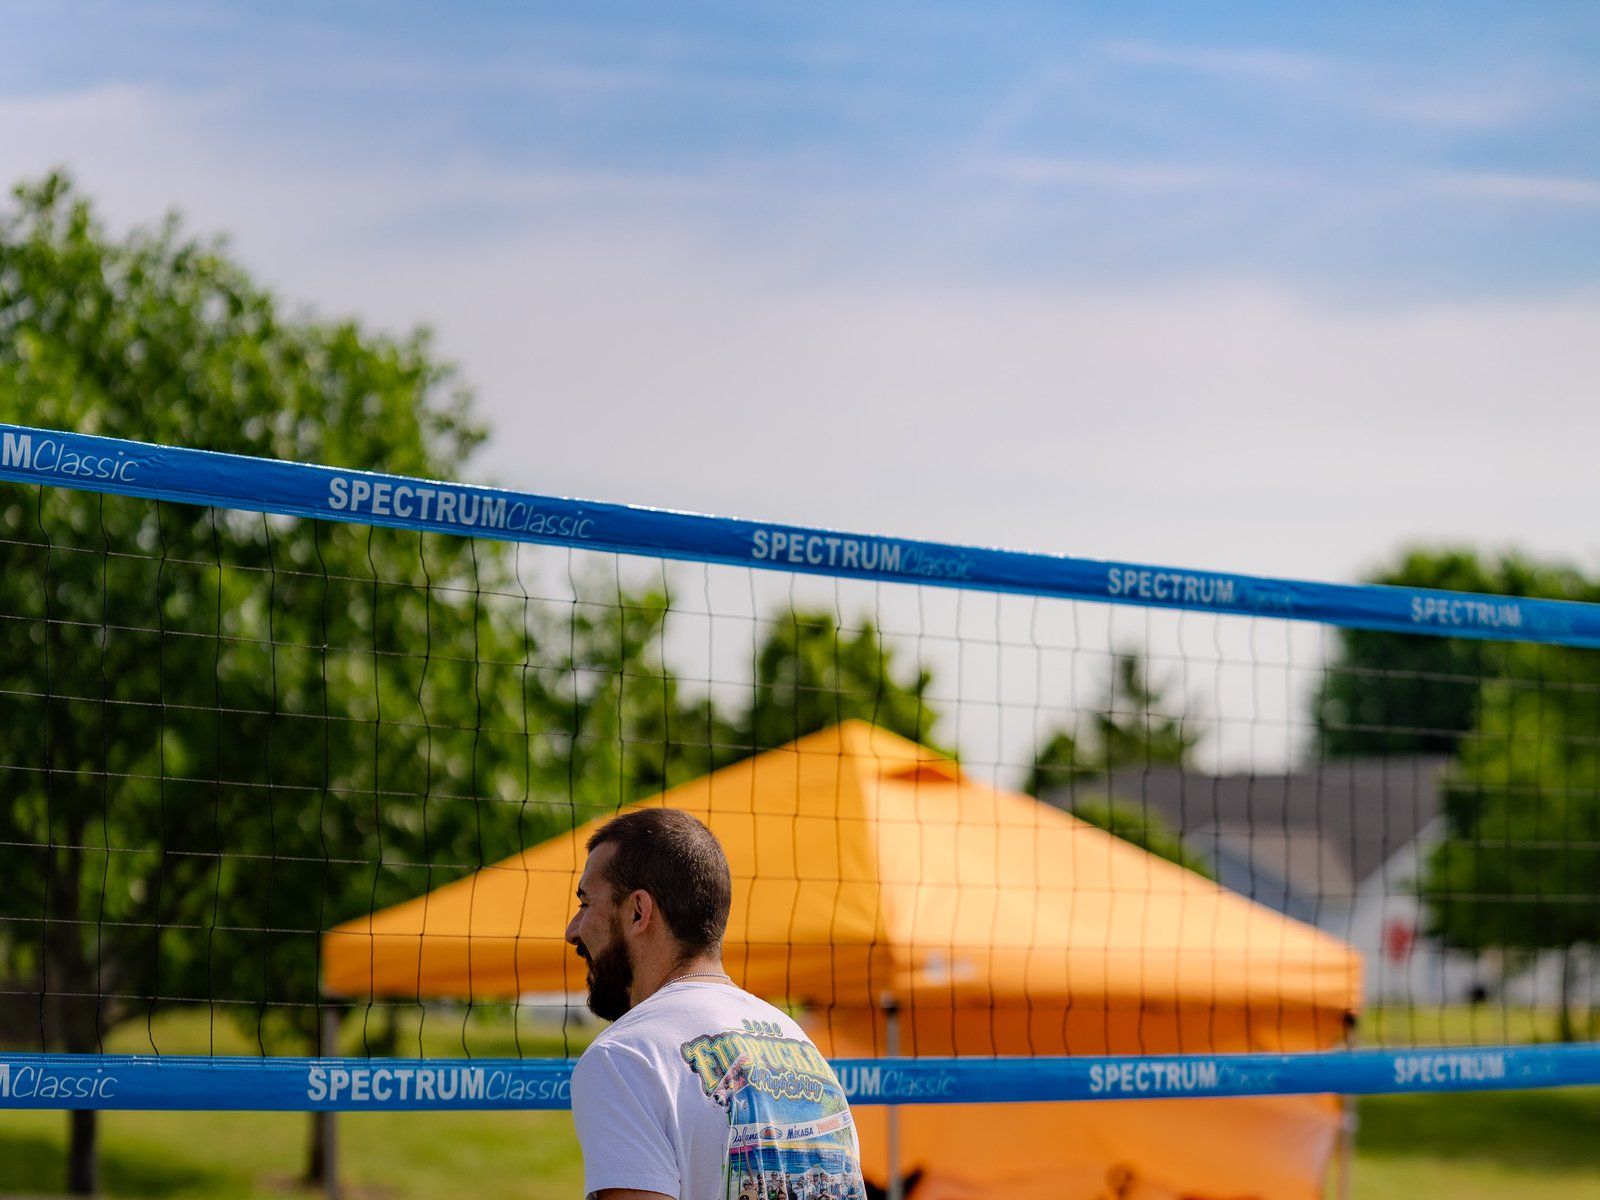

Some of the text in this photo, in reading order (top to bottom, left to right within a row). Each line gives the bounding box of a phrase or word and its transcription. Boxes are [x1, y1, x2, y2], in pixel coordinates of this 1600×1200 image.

[33, 439, 139, 482] Classic
[328, 477, 595, 539] SPECTRUM Classic
[752, 530, 901, 573] SPECTRUM
[1108, 568, 1234, 604] SPECTRUM
[1411, 596, 1522, 628] SPECTRUM
[12, 1066, 118, 1098] Classic
[307, 1067, 485, 1101] SPECTRUM
[1089, 1062, 1217, 1092] SPECTRUM
[1394, 1053, 1505, 1084] SPECTRUM
